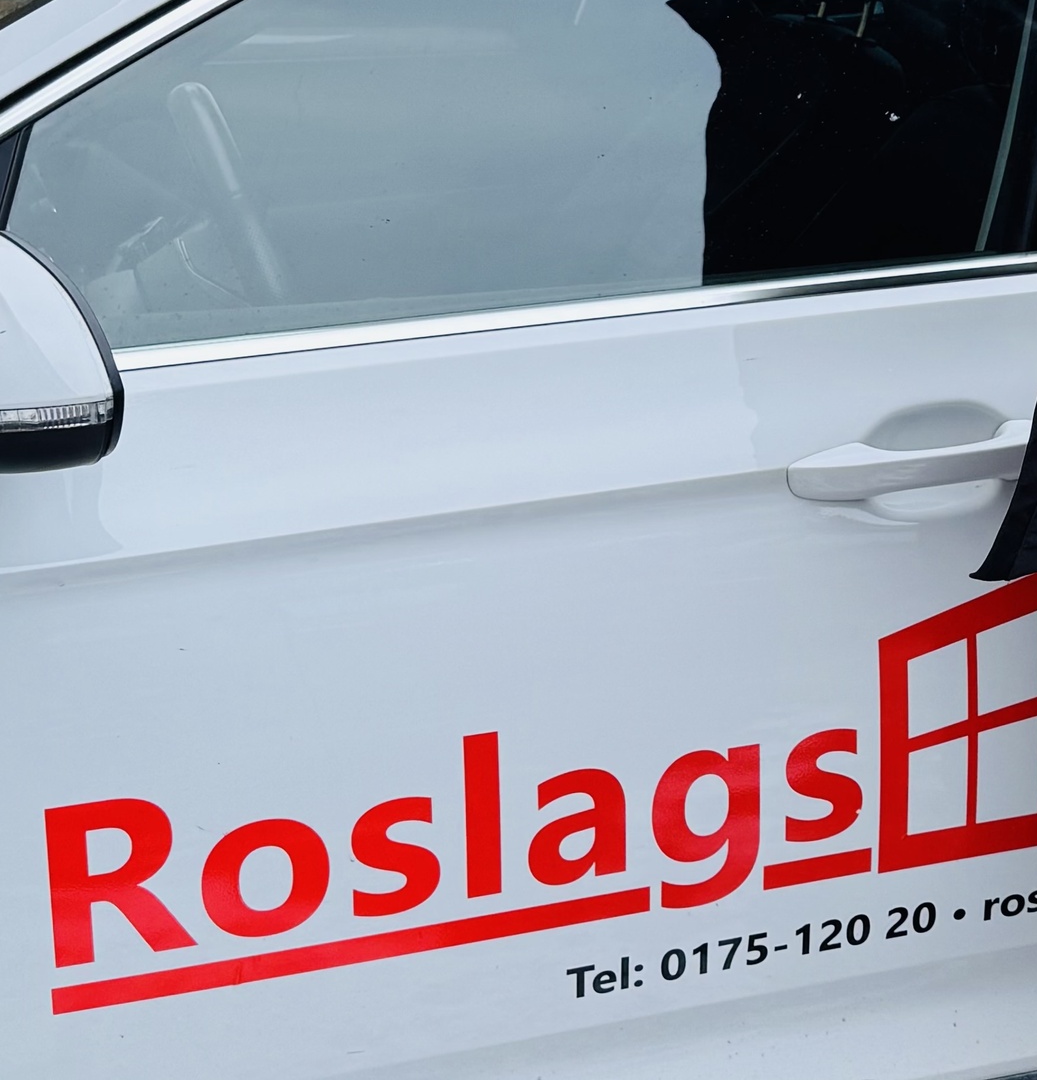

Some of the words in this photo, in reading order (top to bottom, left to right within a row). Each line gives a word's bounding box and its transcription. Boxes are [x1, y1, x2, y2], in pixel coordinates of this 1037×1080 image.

[45, 728, 863, 967] Roslags
[566, 954, 644, 998] Tel:
[660, 914, 871, 981] 0175-120
[886, 901, 937, 940] 20
